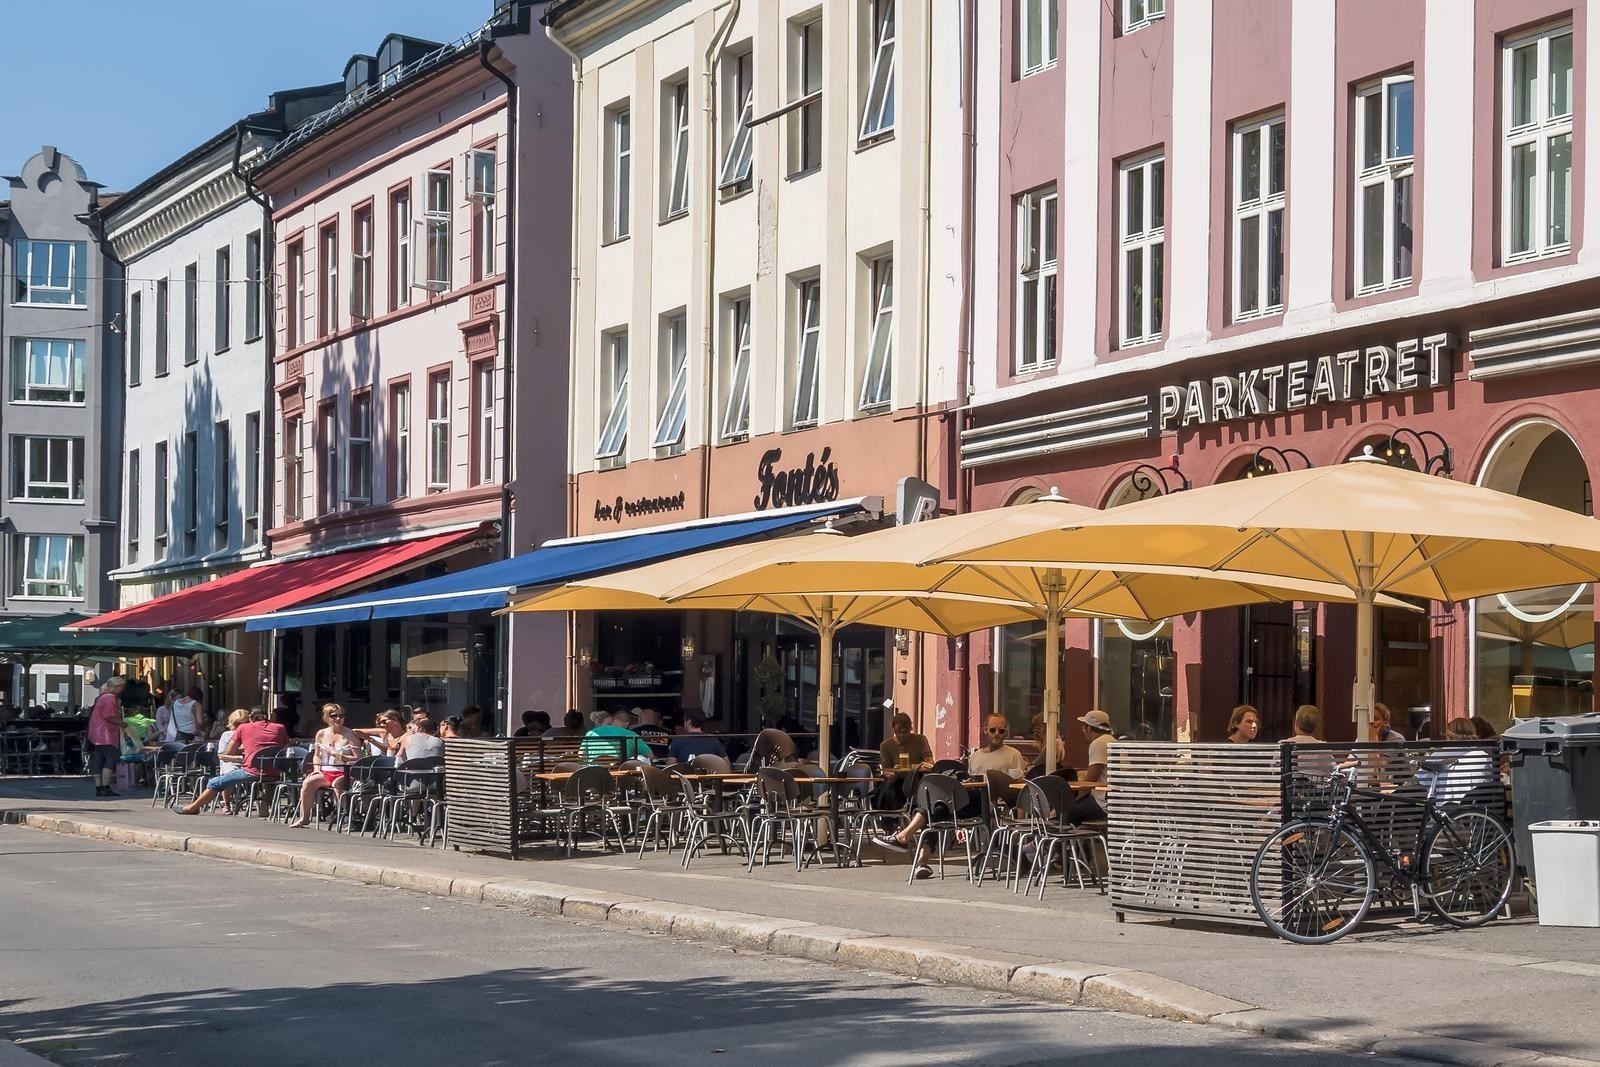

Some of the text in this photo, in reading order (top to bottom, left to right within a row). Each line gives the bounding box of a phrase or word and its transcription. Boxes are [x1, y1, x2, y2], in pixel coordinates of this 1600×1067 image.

[1159, 332, 1449, 431] PARKTEATRET
[624, 491, 685, 517] restaurant
[753, 446, 840, 511] Fontés
